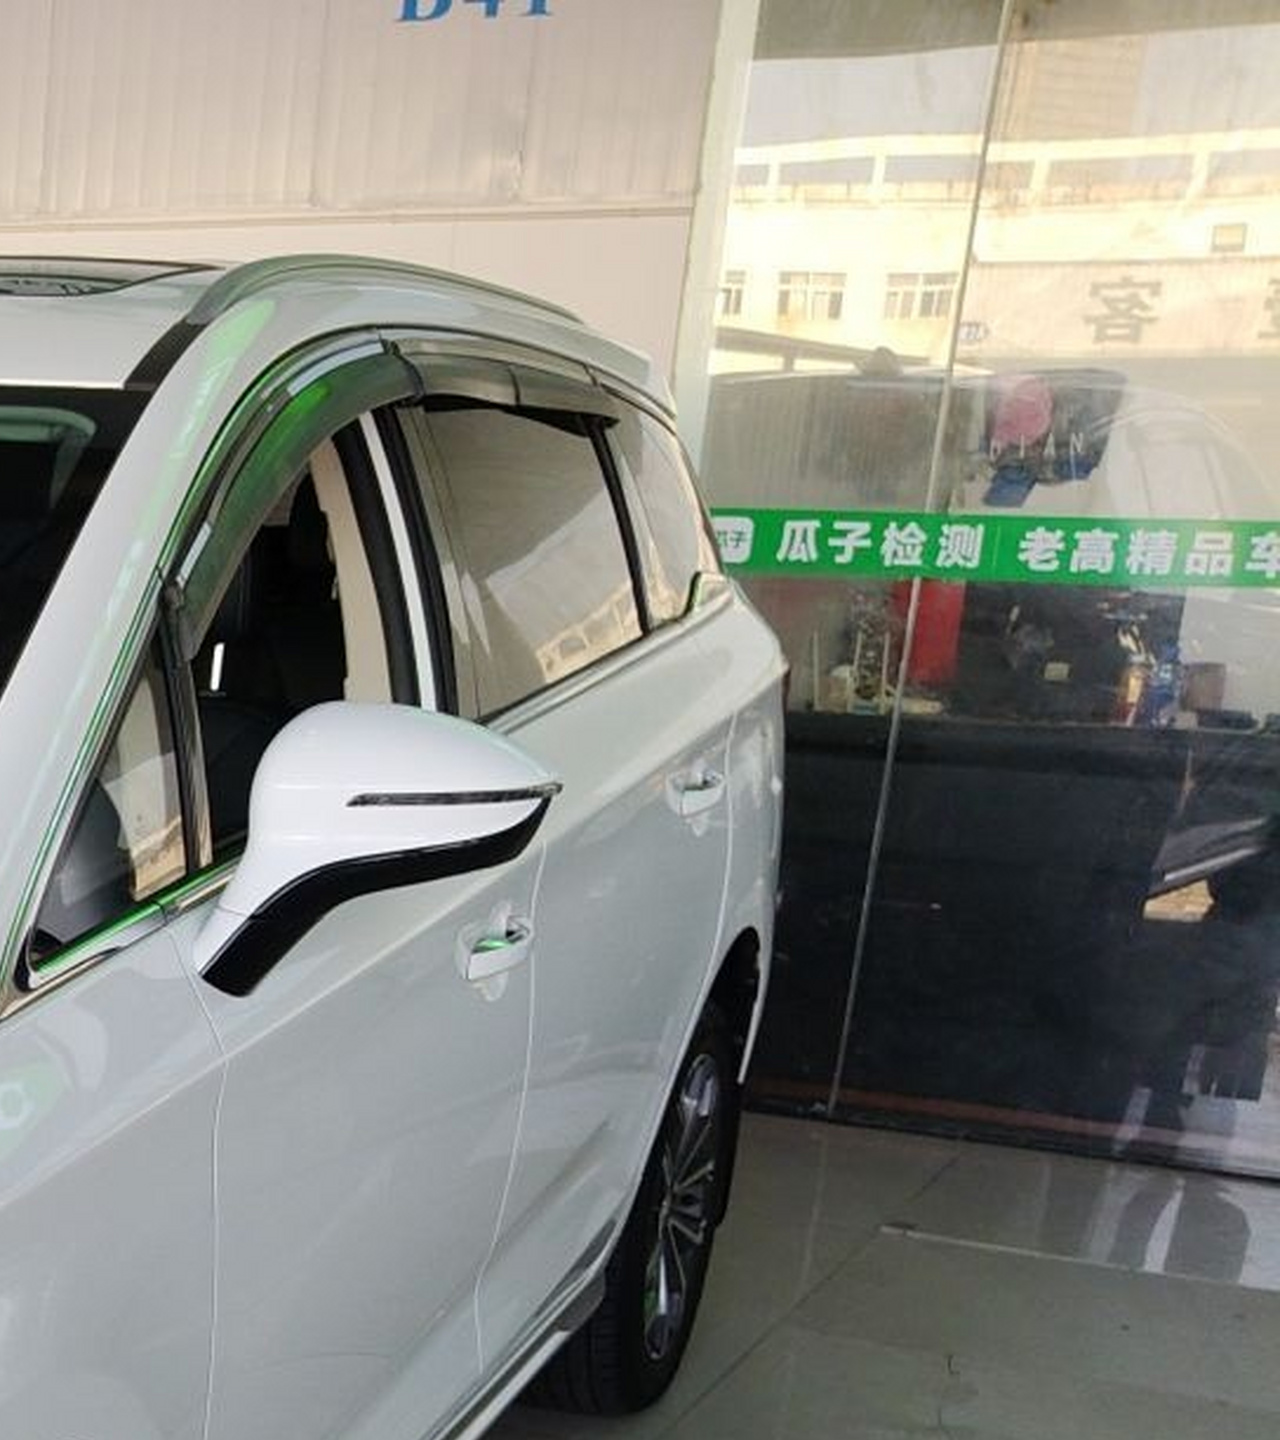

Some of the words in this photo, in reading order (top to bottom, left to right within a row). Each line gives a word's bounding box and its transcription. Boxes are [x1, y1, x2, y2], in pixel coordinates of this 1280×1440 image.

[776, 519, 985, 568] 瓜子检测
[1017, 526, 1280, 578] 老高精品车
